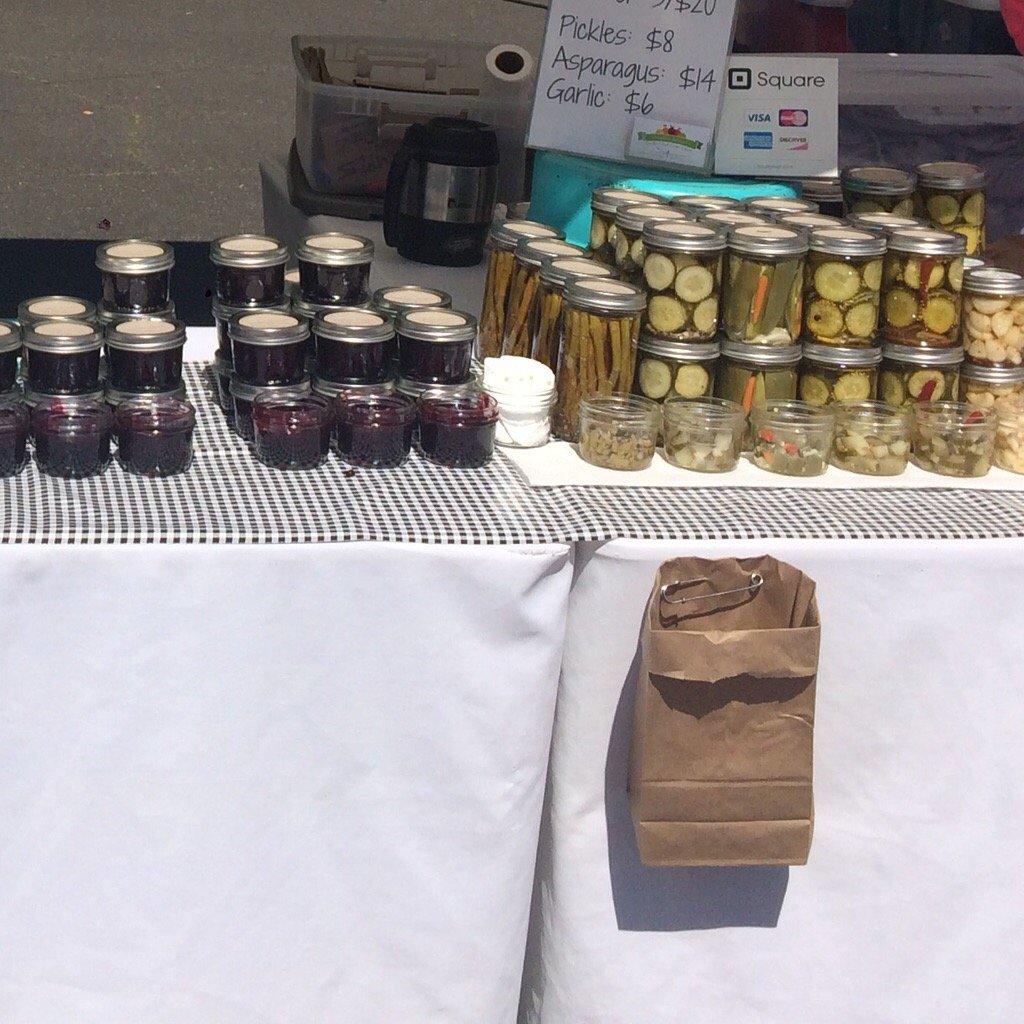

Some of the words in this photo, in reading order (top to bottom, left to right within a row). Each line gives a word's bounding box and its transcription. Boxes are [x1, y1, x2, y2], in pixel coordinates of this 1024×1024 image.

[559, 15, 632, 46] Pickles:
[646, 27, 675, 53] $8
[552, 46, 666, 88] Asparagus:
[679, 65, 716, 93] $14
[757, 71, 826, 90] Square
[547, 78, 611, 108] Garlic:
[625, 90, 654, 115] $6
[748, 114, 771, 122] VISA
